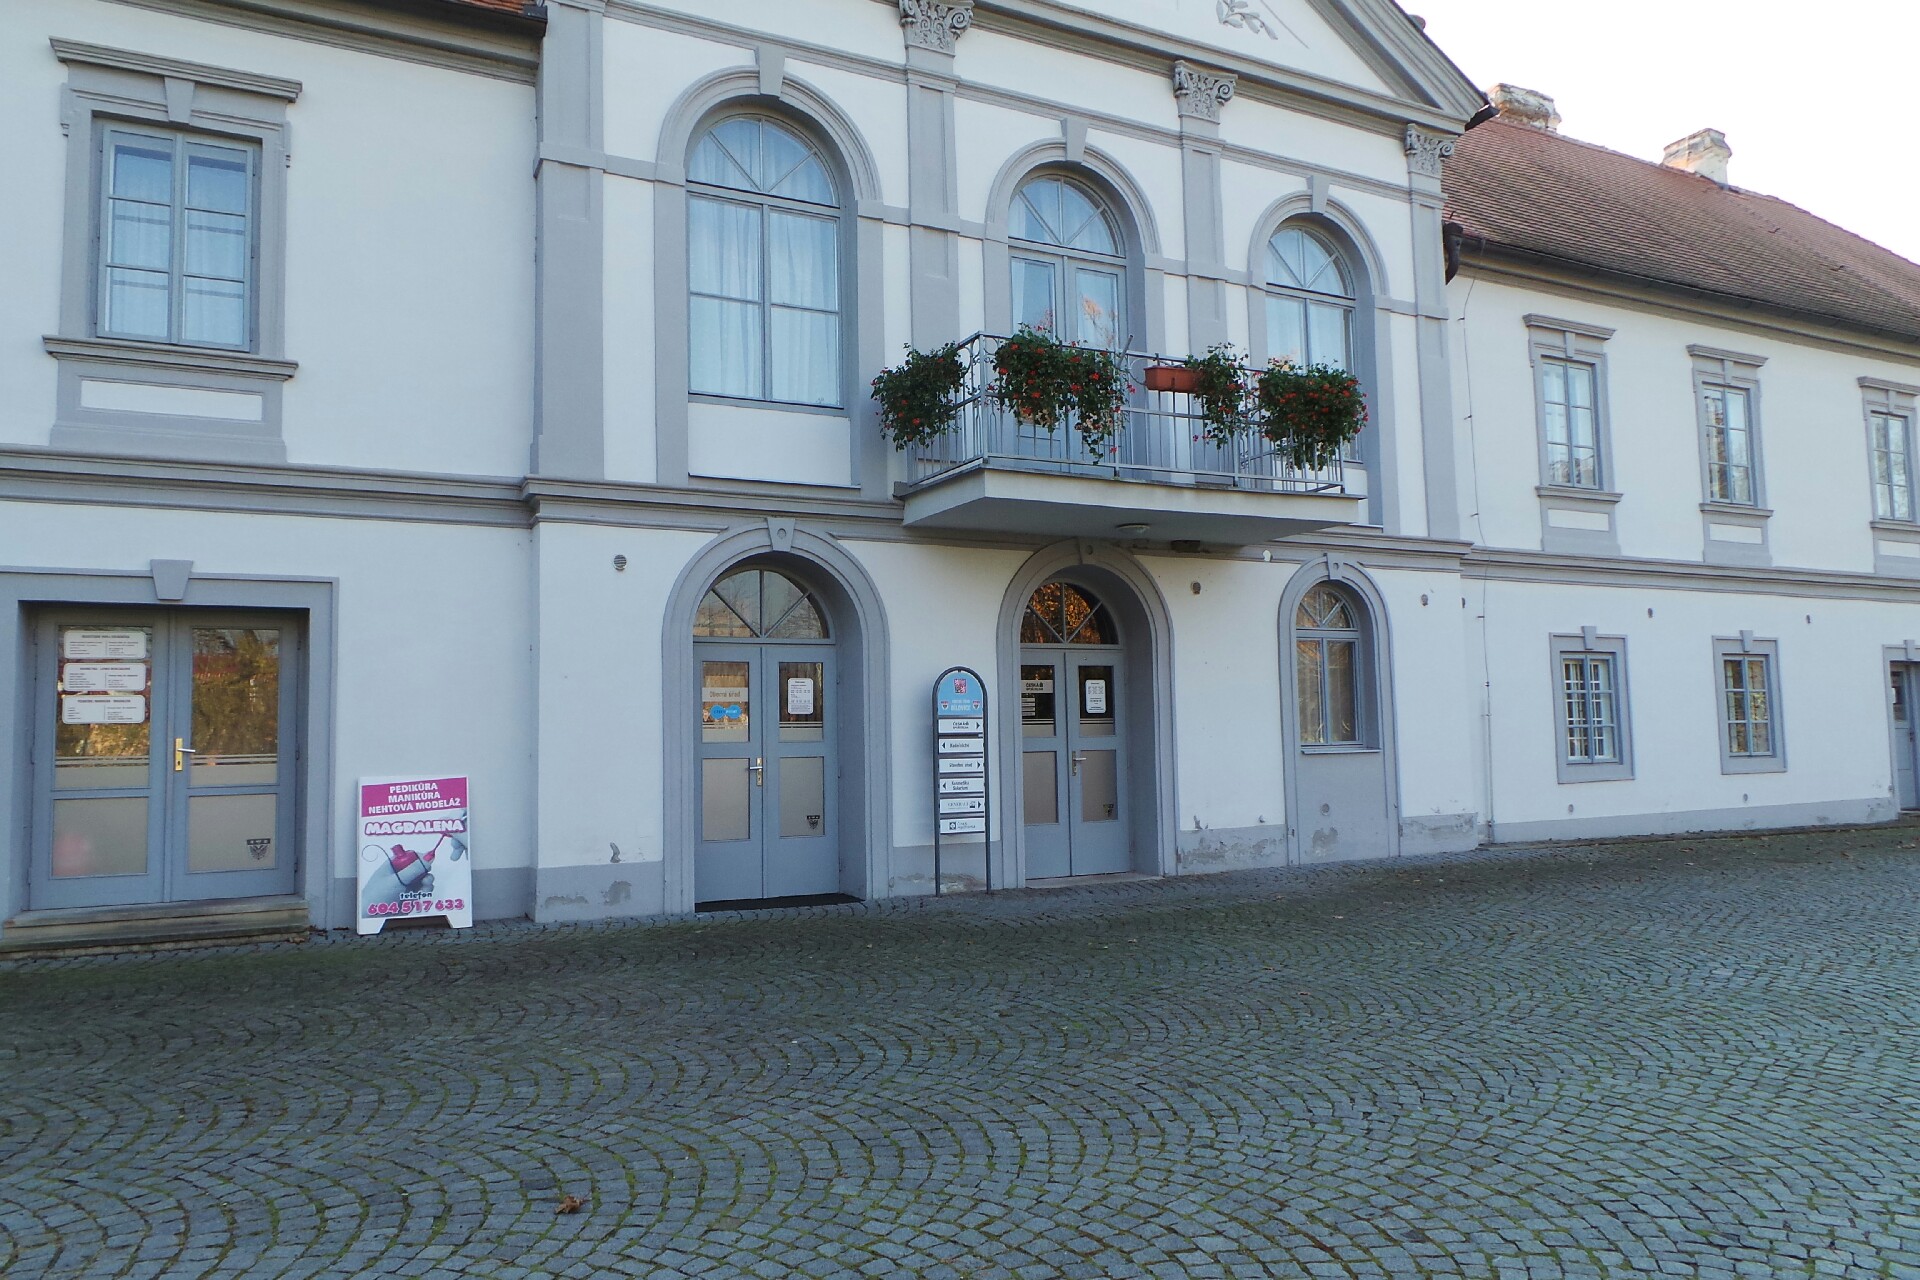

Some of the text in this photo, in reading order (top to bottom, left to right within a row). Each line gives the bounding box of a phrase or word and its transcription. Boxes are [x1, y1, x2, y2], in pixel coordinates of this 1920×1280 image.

[389, 782, 438, 794] PEDIKÚRA
[388, 791, 440, 804] MANIKÚRA
[368, 802, 413, 814] NEHTOVÁ
[365, 819, 466, 835] MAGDALENA
[400, 890, 433, 900] telefon
[367, 898, 465, 916] 604 517 633
